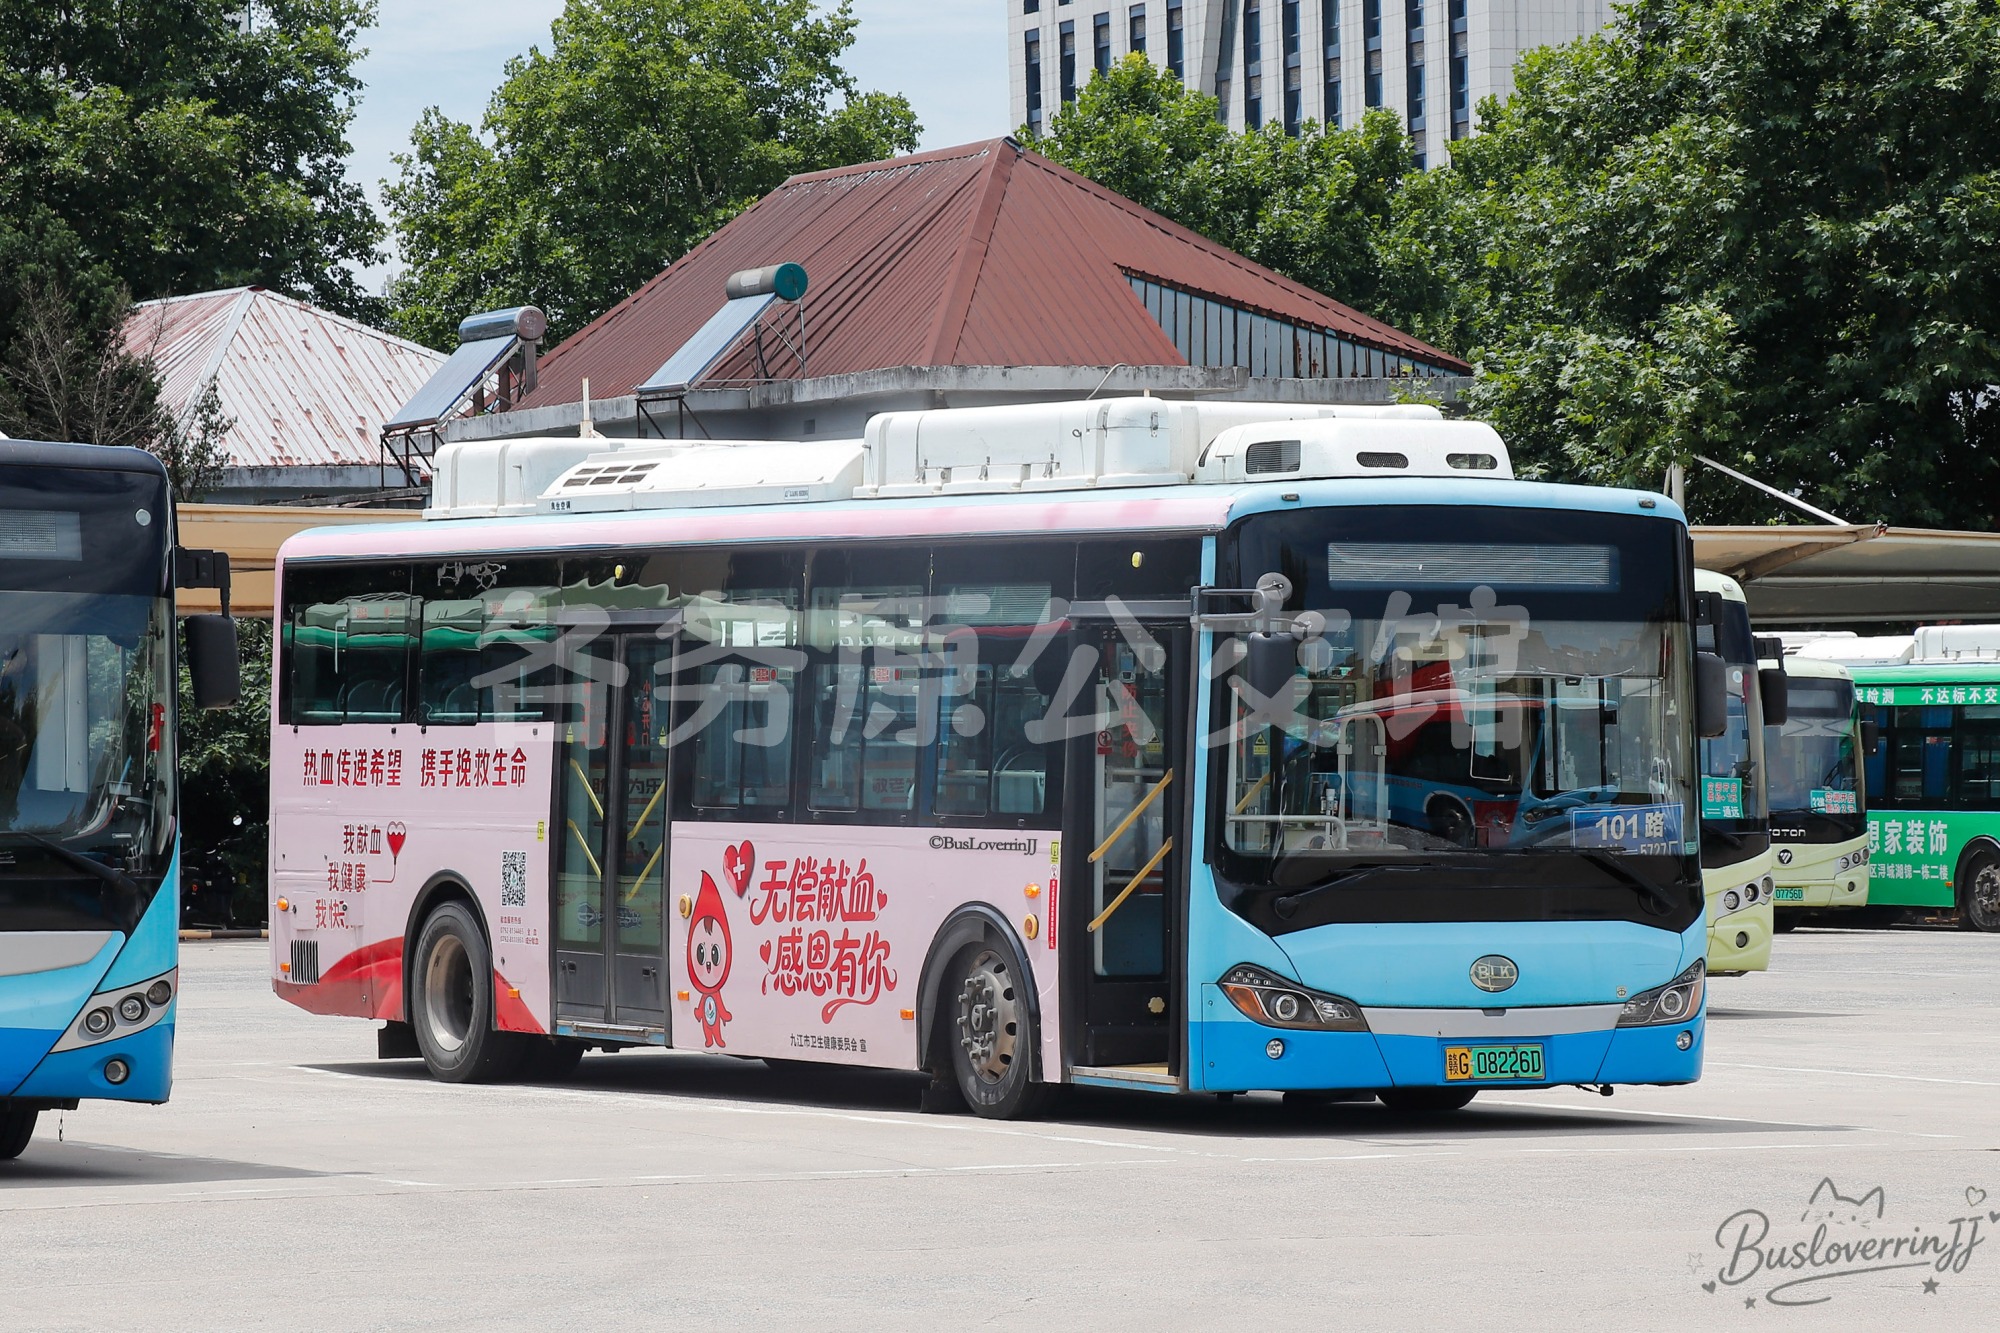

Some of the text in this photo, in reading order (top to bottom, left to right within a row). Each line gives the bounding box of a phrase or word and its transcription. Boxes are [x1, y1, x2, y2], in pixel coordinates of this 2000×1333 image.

[1921, 687, 1998, 705] 不达标不交
[303, 747, 527, 788] 热血传递希望 携手挽救生命
[343, 823, 382, 855] 我献血
[328, 861, 366, 892] 我健康
[750, 856, 877, 925] 无偿献血
[761, 927, 898, 1024] 感恩有你
[790, 1033, 857, 1052] 九江市卫生健康委员会
